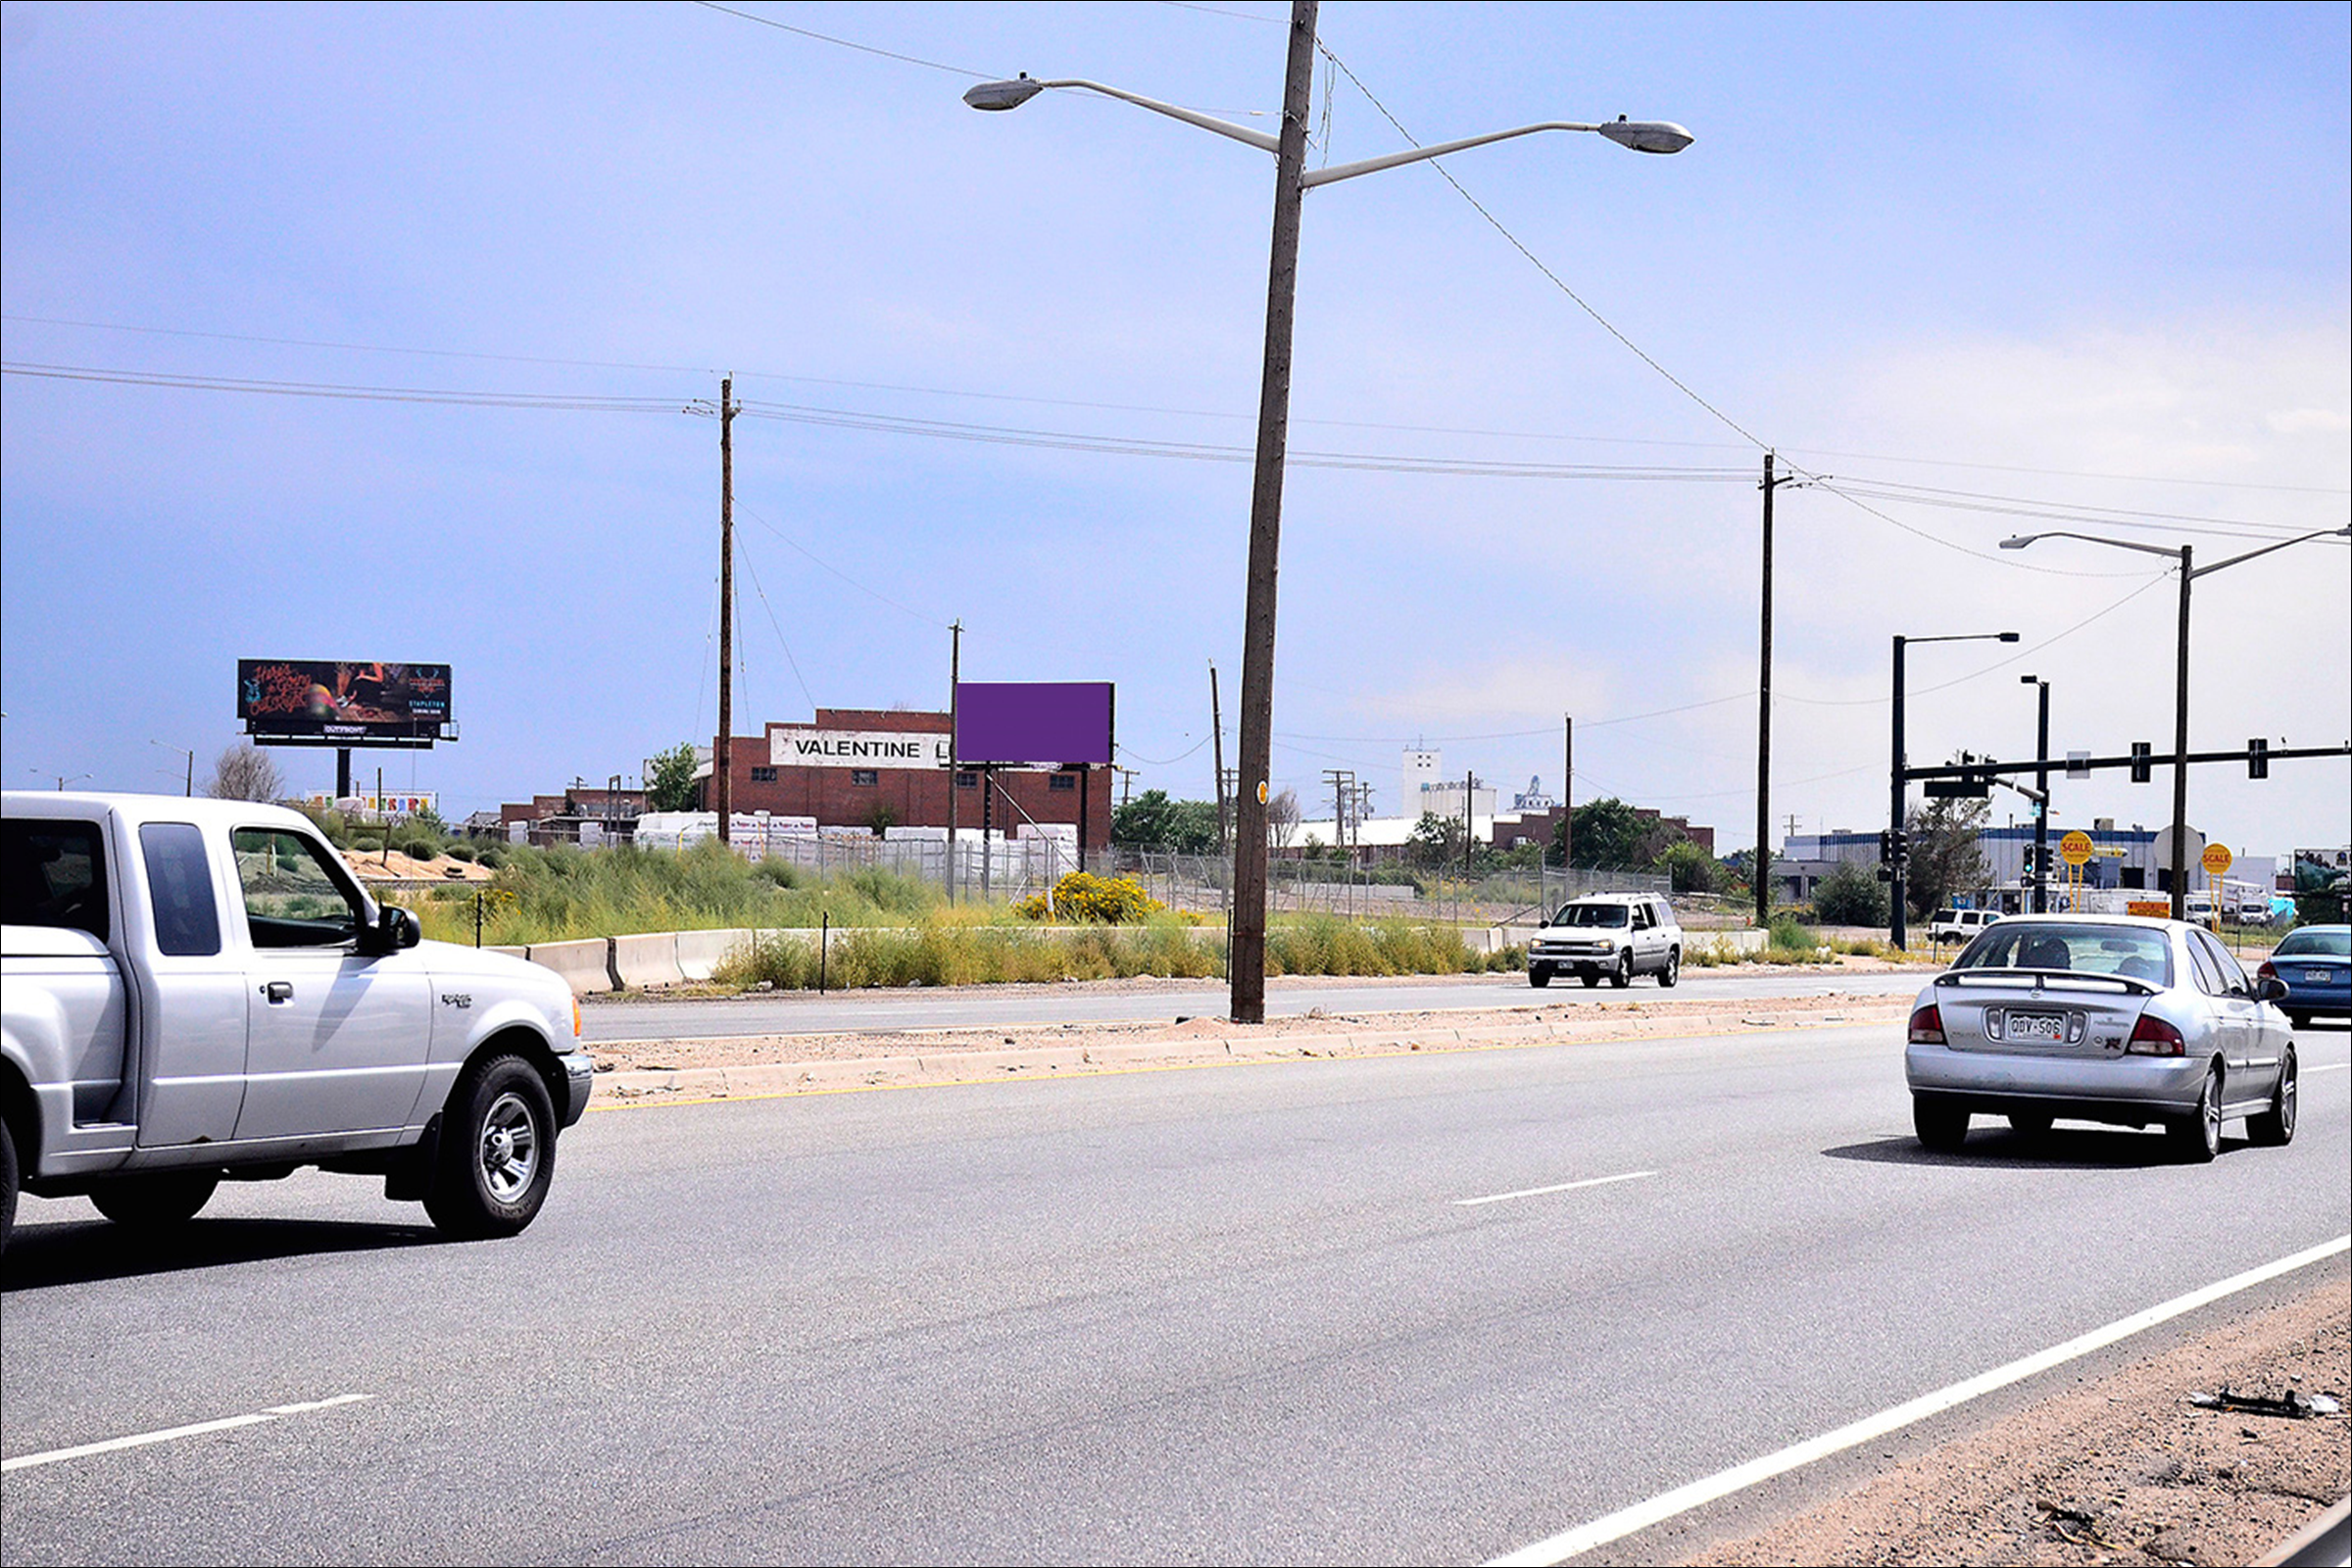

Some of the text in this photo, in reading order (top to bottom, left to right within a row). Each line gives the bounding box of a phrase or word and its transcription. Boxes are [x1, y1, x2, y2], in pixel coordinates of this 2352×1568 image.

[795, 740, 920, 758] VALENTINE
[2061, 842, 2091, 852] SCALE
[2202, 854, 2230, 863] SCALE
